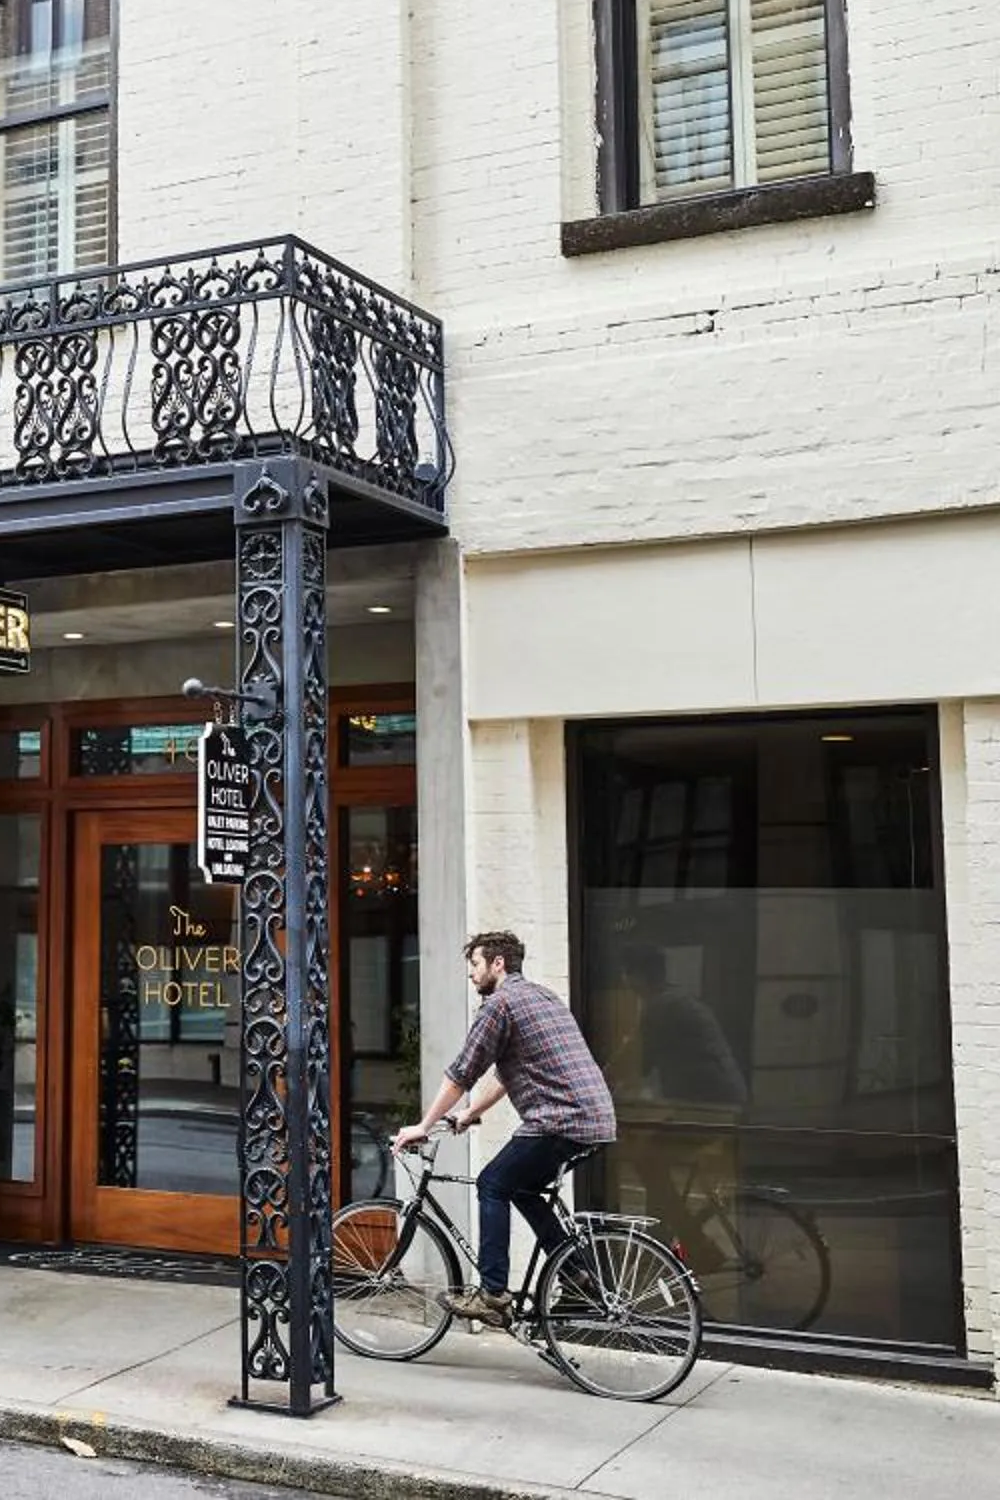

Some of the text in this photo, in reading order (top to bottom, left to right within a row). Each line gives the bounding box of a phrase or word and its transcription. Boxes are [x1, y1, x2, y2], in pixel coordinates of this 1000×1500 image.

[207, 759, 249, 785] OLIVER
[210, 786, 247, 809] HOTEL
[169, 905, 207, 936] The
[136, 945, 242, 973] OLIVER
[144, 981, 232, 1008] HOTEL
